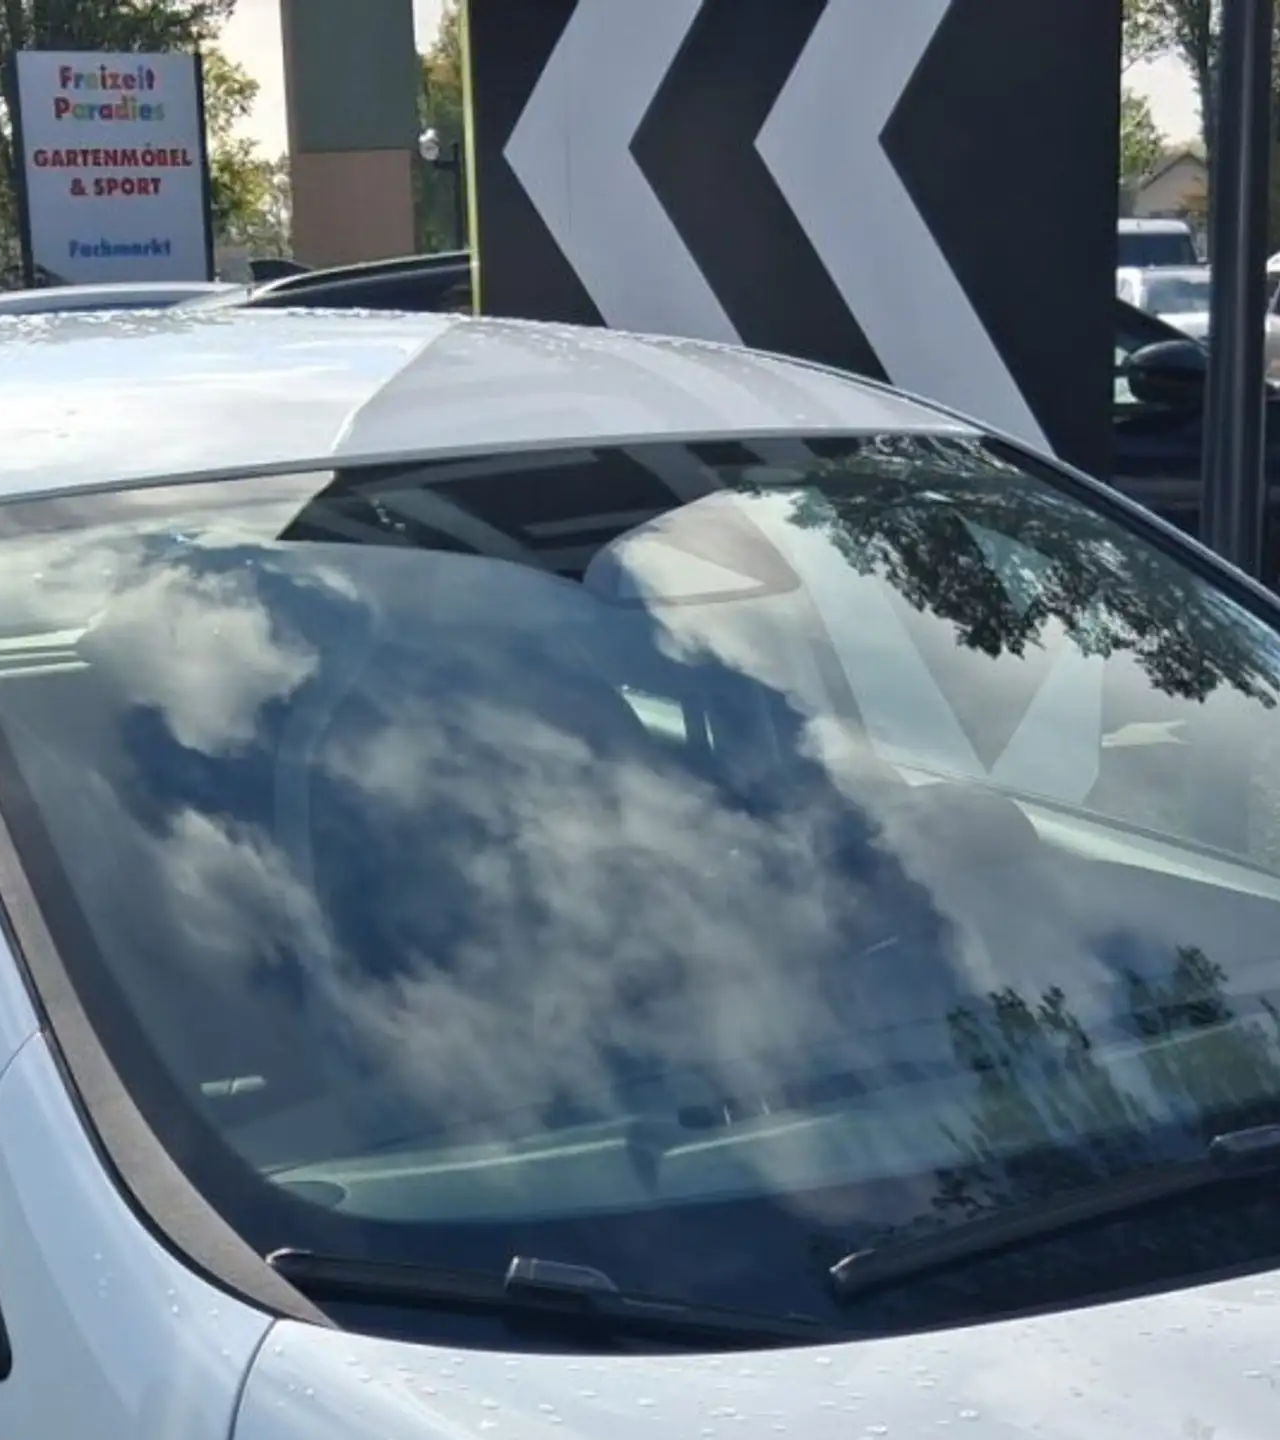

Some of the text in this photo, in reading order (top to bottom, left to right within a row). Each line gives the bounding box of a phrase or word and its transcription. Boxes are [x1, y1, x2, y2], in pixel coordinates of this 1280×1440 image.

[58, 64, 155, 91] Freizeit
[54, 96, 165, 121] Paradies
[33, 143, 193, 167] GARTENMÖBEL
[70, 177, 162, 196] & SPORT
[68, 238, 171, 259] Fachmarkt
